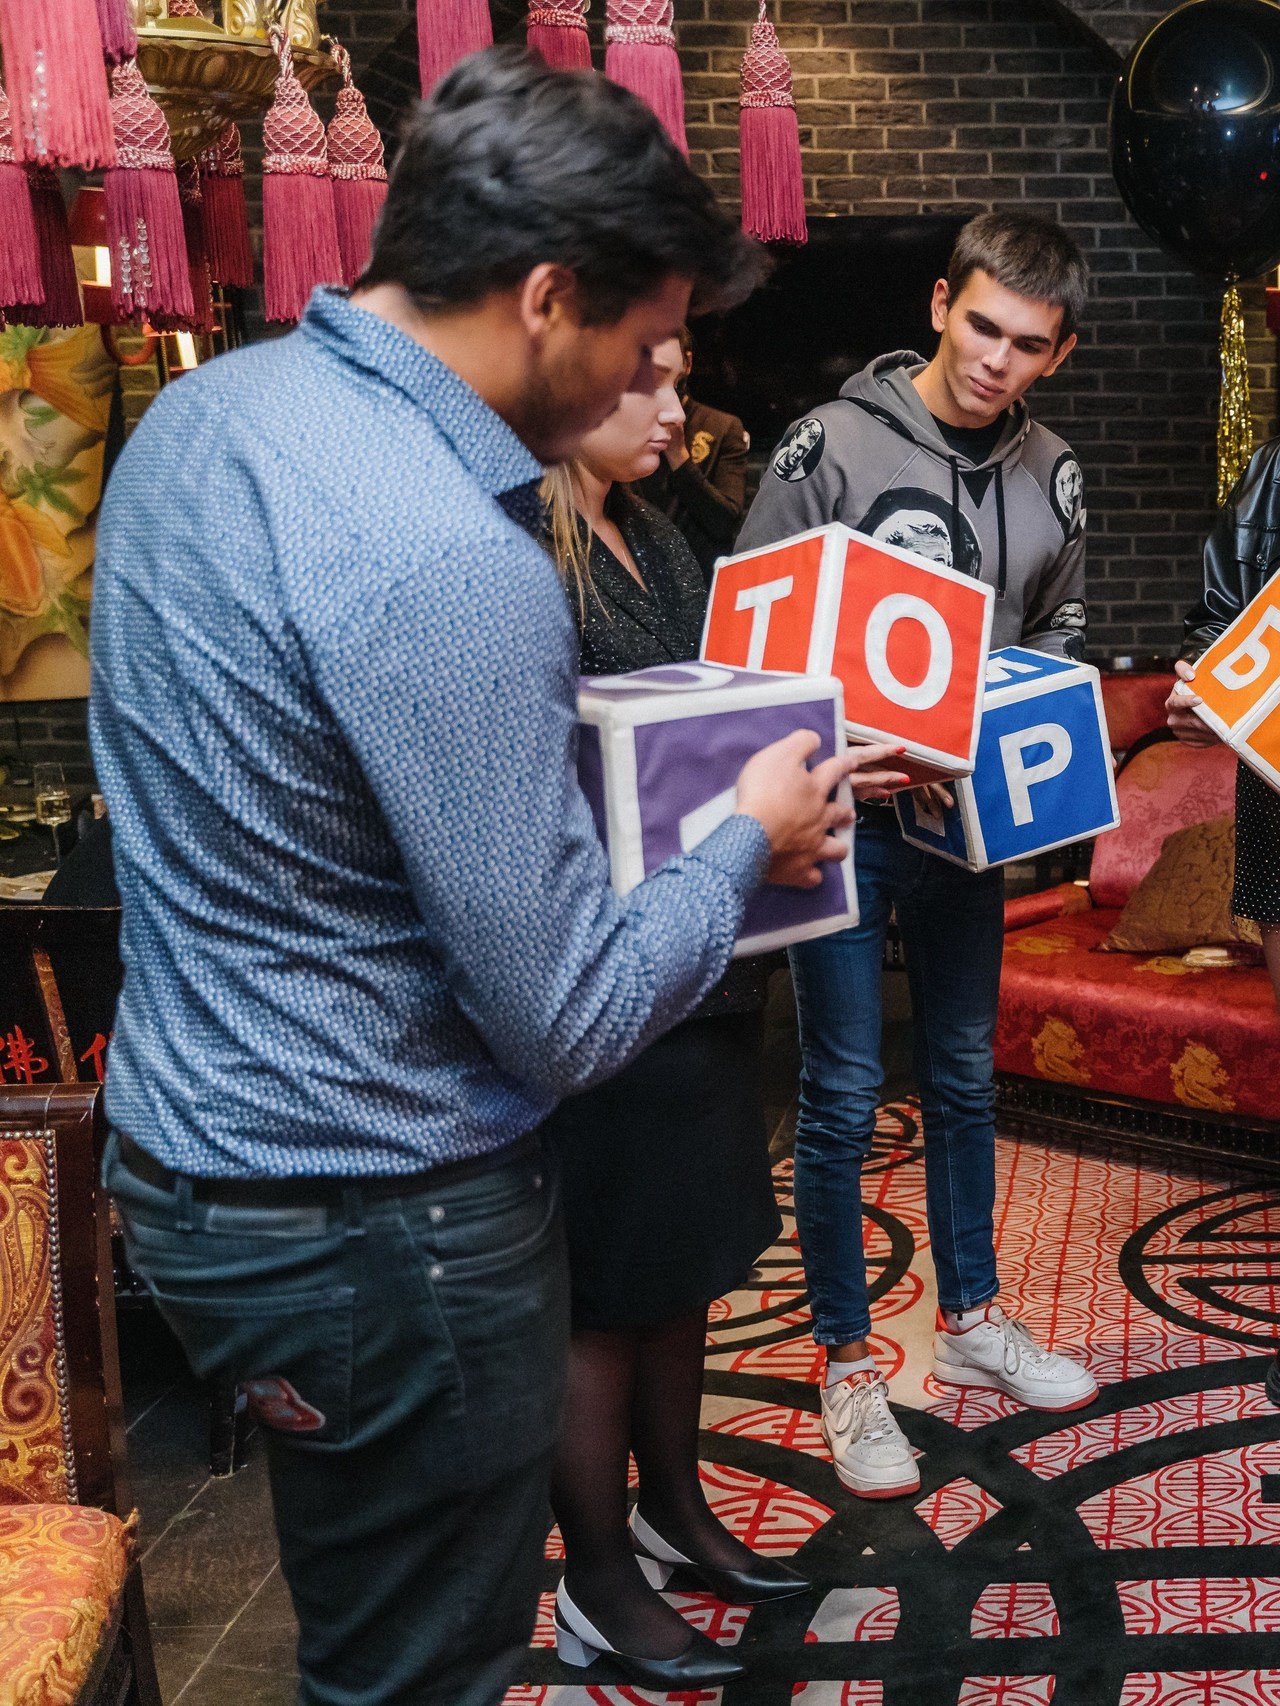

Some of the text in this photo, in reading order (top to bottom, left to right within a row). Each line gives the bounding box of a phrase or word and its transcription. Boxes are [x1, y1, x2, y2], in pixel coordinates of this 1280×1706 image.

[736, 576, 793, 670] Т
[866, 593, 952, 710] О
[1000, 723, 1072, 827] Р
